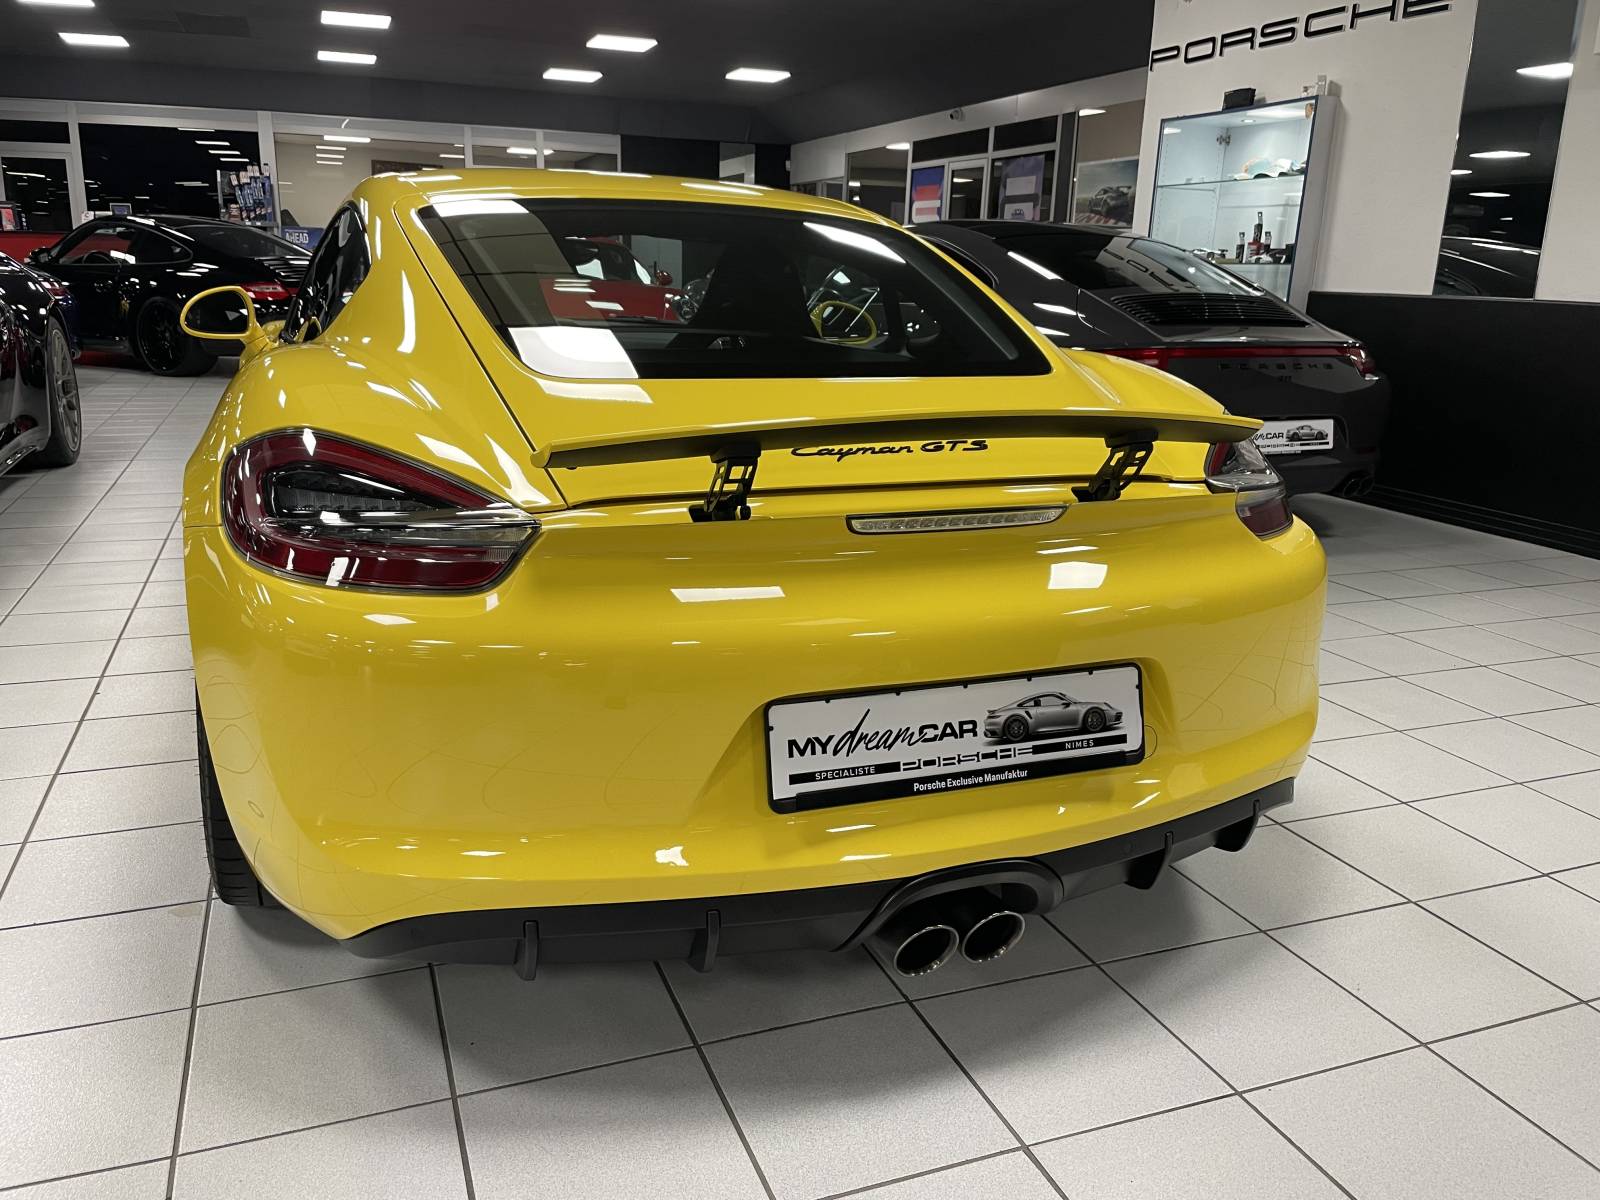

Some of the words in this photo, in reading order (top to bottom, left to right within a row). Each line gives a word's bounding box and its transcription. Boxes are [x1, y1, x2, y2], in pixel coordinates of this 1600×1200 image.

[1149, 0, 1451, 72] PORSCHE
[285, 232, 309, 244] AHEAD
[1265, 432, 1285, 440] CAR
[791, 445, 914, 463] Cayman
[919, 439, 989, 453] GTS
[815, 765, 876, 781] SPECIALISTE
[900, 746, 1033, 772] PORSCHE
[1065, 739, 1095, 750] NIMES
[913, 780, 946, 792] Porsche
[946, 774, 984, 788] Exclusive
[984, 769, 1028, 782] Manufaktur
